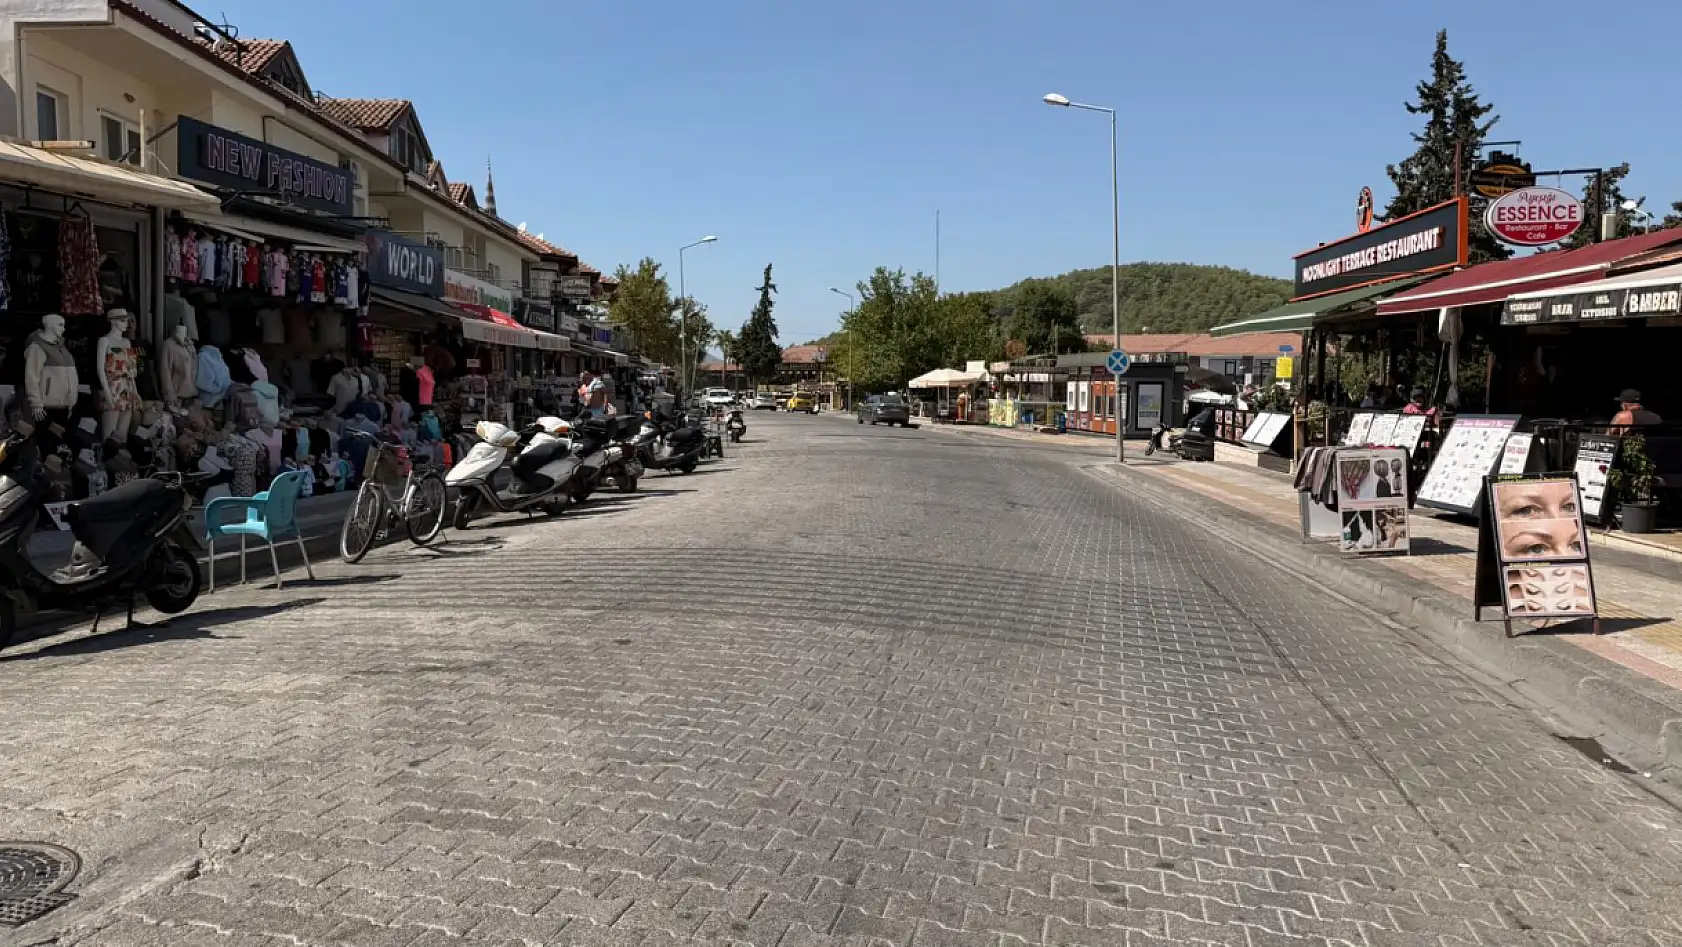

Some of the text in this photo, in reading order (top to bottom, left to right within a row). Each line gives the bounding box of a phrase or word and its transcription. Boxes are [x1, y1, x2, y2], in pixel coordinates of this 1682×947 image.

[207, 132, 347, 205] NEW FASHION
[1497, 205, 1577, 222] ESSENCE
[1505, 223, 1547, 233] Restaurant
[1554, 223, 1568, 231] Bar
[387, 242, 435, 285] WORLD
[1301, 227, 1441, 284] MOONLIGHT TERRACE RESTAURANT
[1629, 290, 1677, 313] BARBER
